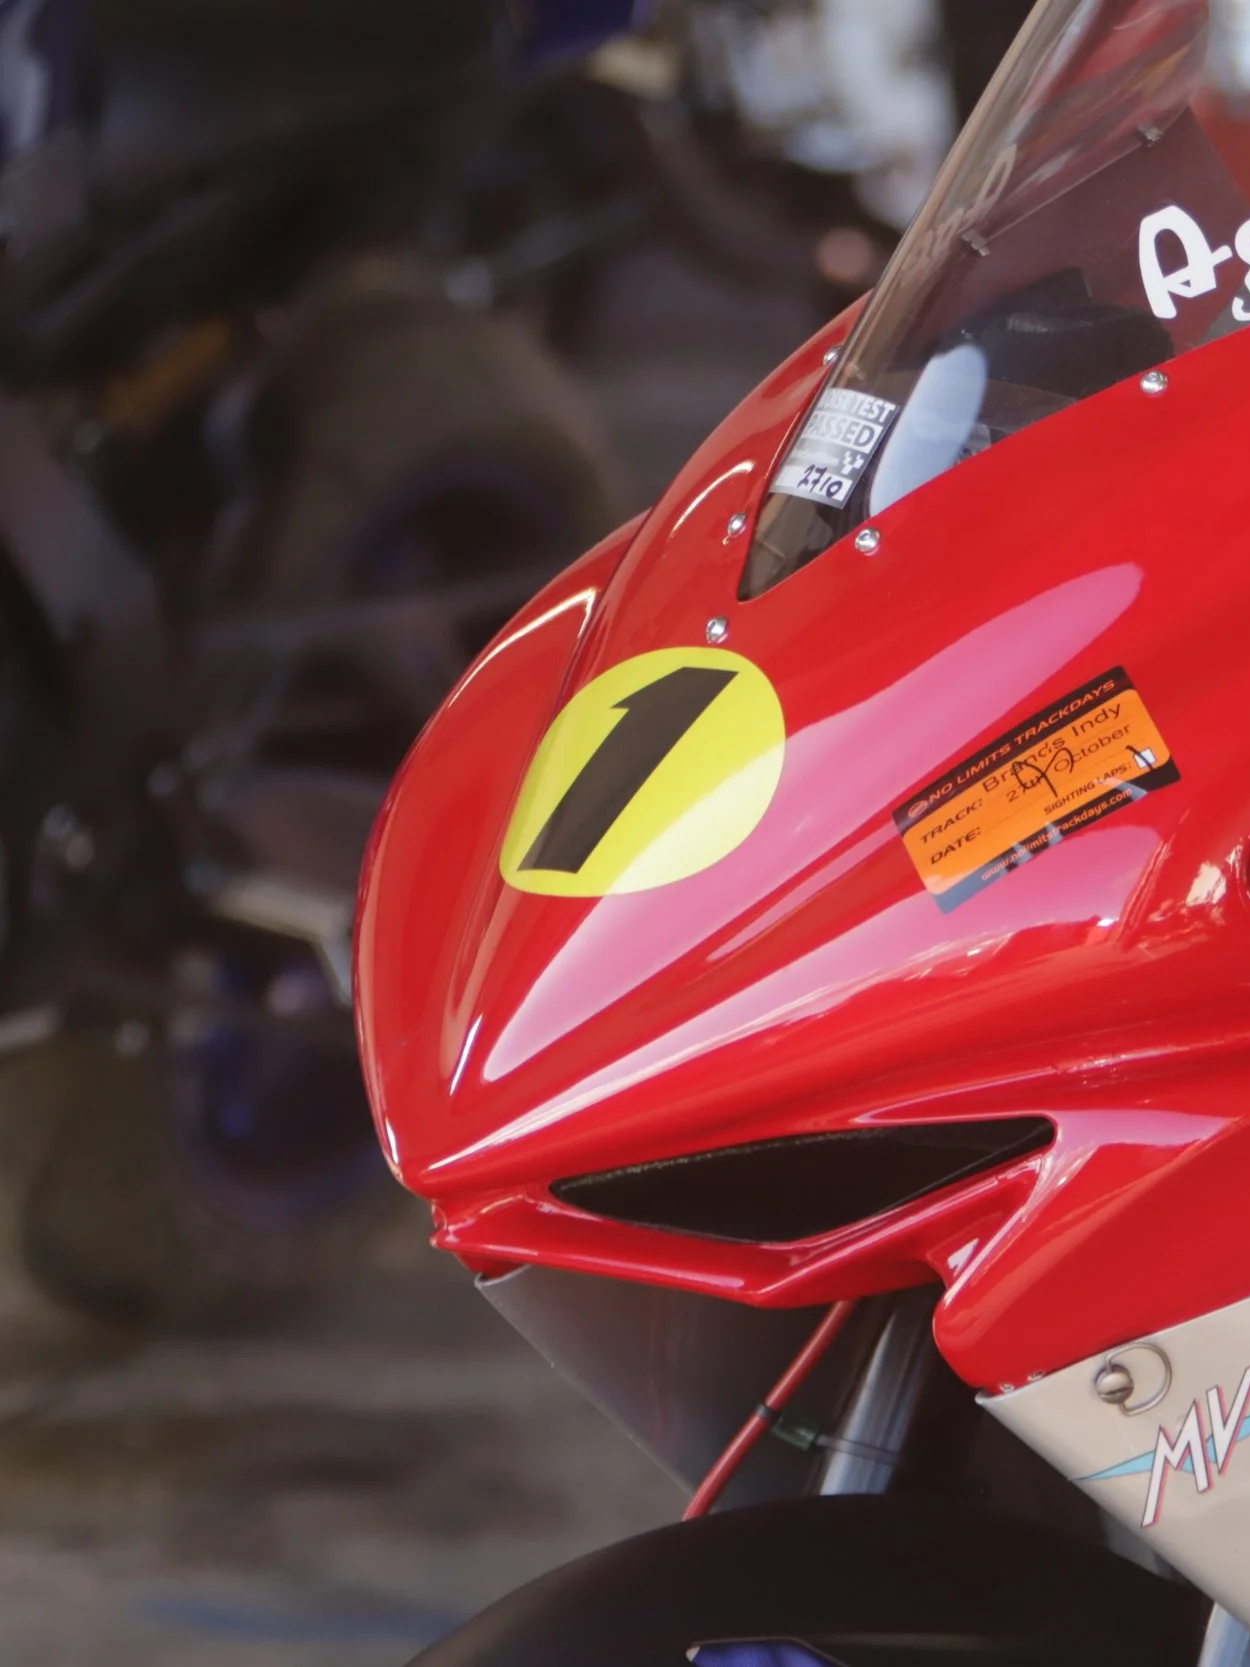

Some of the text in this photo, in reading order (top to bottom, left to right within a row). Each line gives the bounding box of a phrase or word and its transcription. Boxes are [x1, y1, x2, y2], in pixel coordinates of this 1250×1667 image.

[804, 412, 876, 448] PASSED
[851, 394, 897, 423] TEST
[516, 666, 740, 874] 1
[921, 798, 983, 844] TRACK:
[1071, 703, 1121, 737] Indy
[929, 782, 953, 803] NO
[956, 743, 1012, 784] LIMITS
[1014, 679, 1116, 745] TRACKDAYS
[930, 826, 981, 865] DATE:
[1053, 723, 1132, 773] October
[1043, 782, 1096, 816] SIGHTING
[1097, 762, 1133, 785] LAPS:
[981, 788, 1134, 881] www.nolimitstrackdays.com
